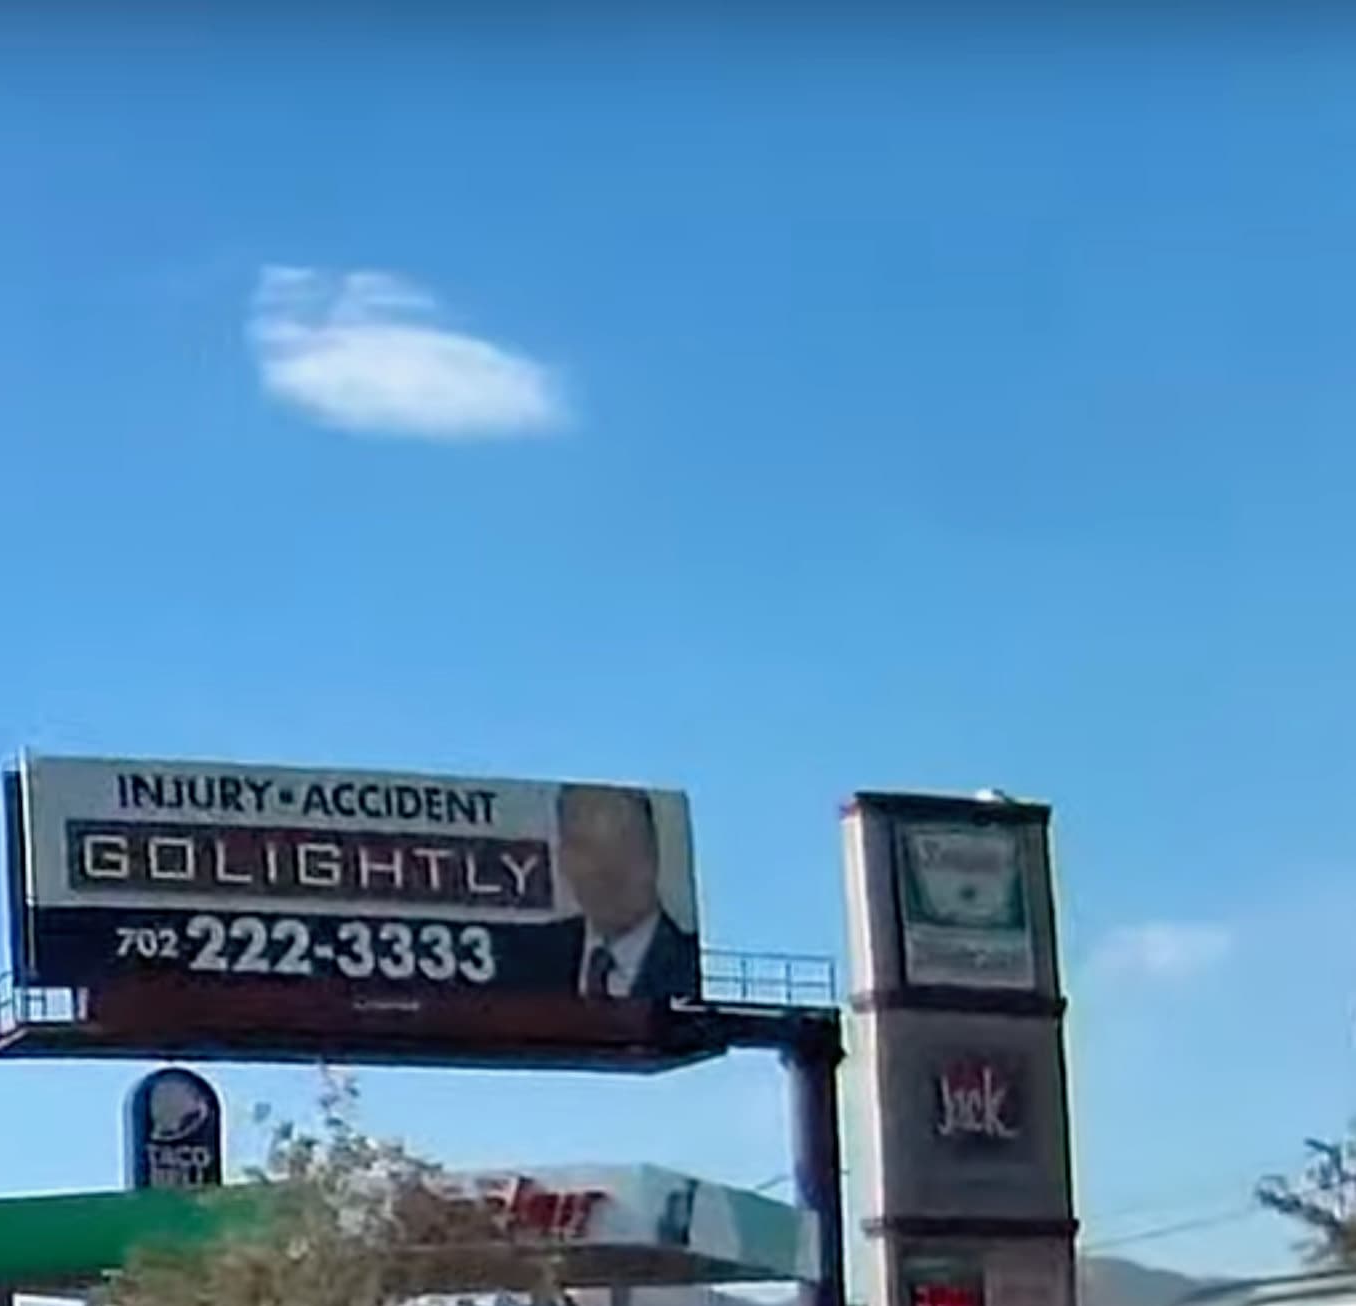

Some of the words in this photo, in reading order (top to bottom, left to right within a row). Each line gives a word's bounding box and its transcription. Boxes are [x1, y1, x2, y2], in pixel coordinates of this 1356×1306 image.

[116, 774, 273, 813] INJURY
[303, 783, 498, 825] ACCIDENT
[83, 834, 539, 895] GOLIGHTLY
[115, 927, 179, 958] 702
[187, 914, 495, 982] 222-3333
[147, 1144, 210, 1167] TACO
